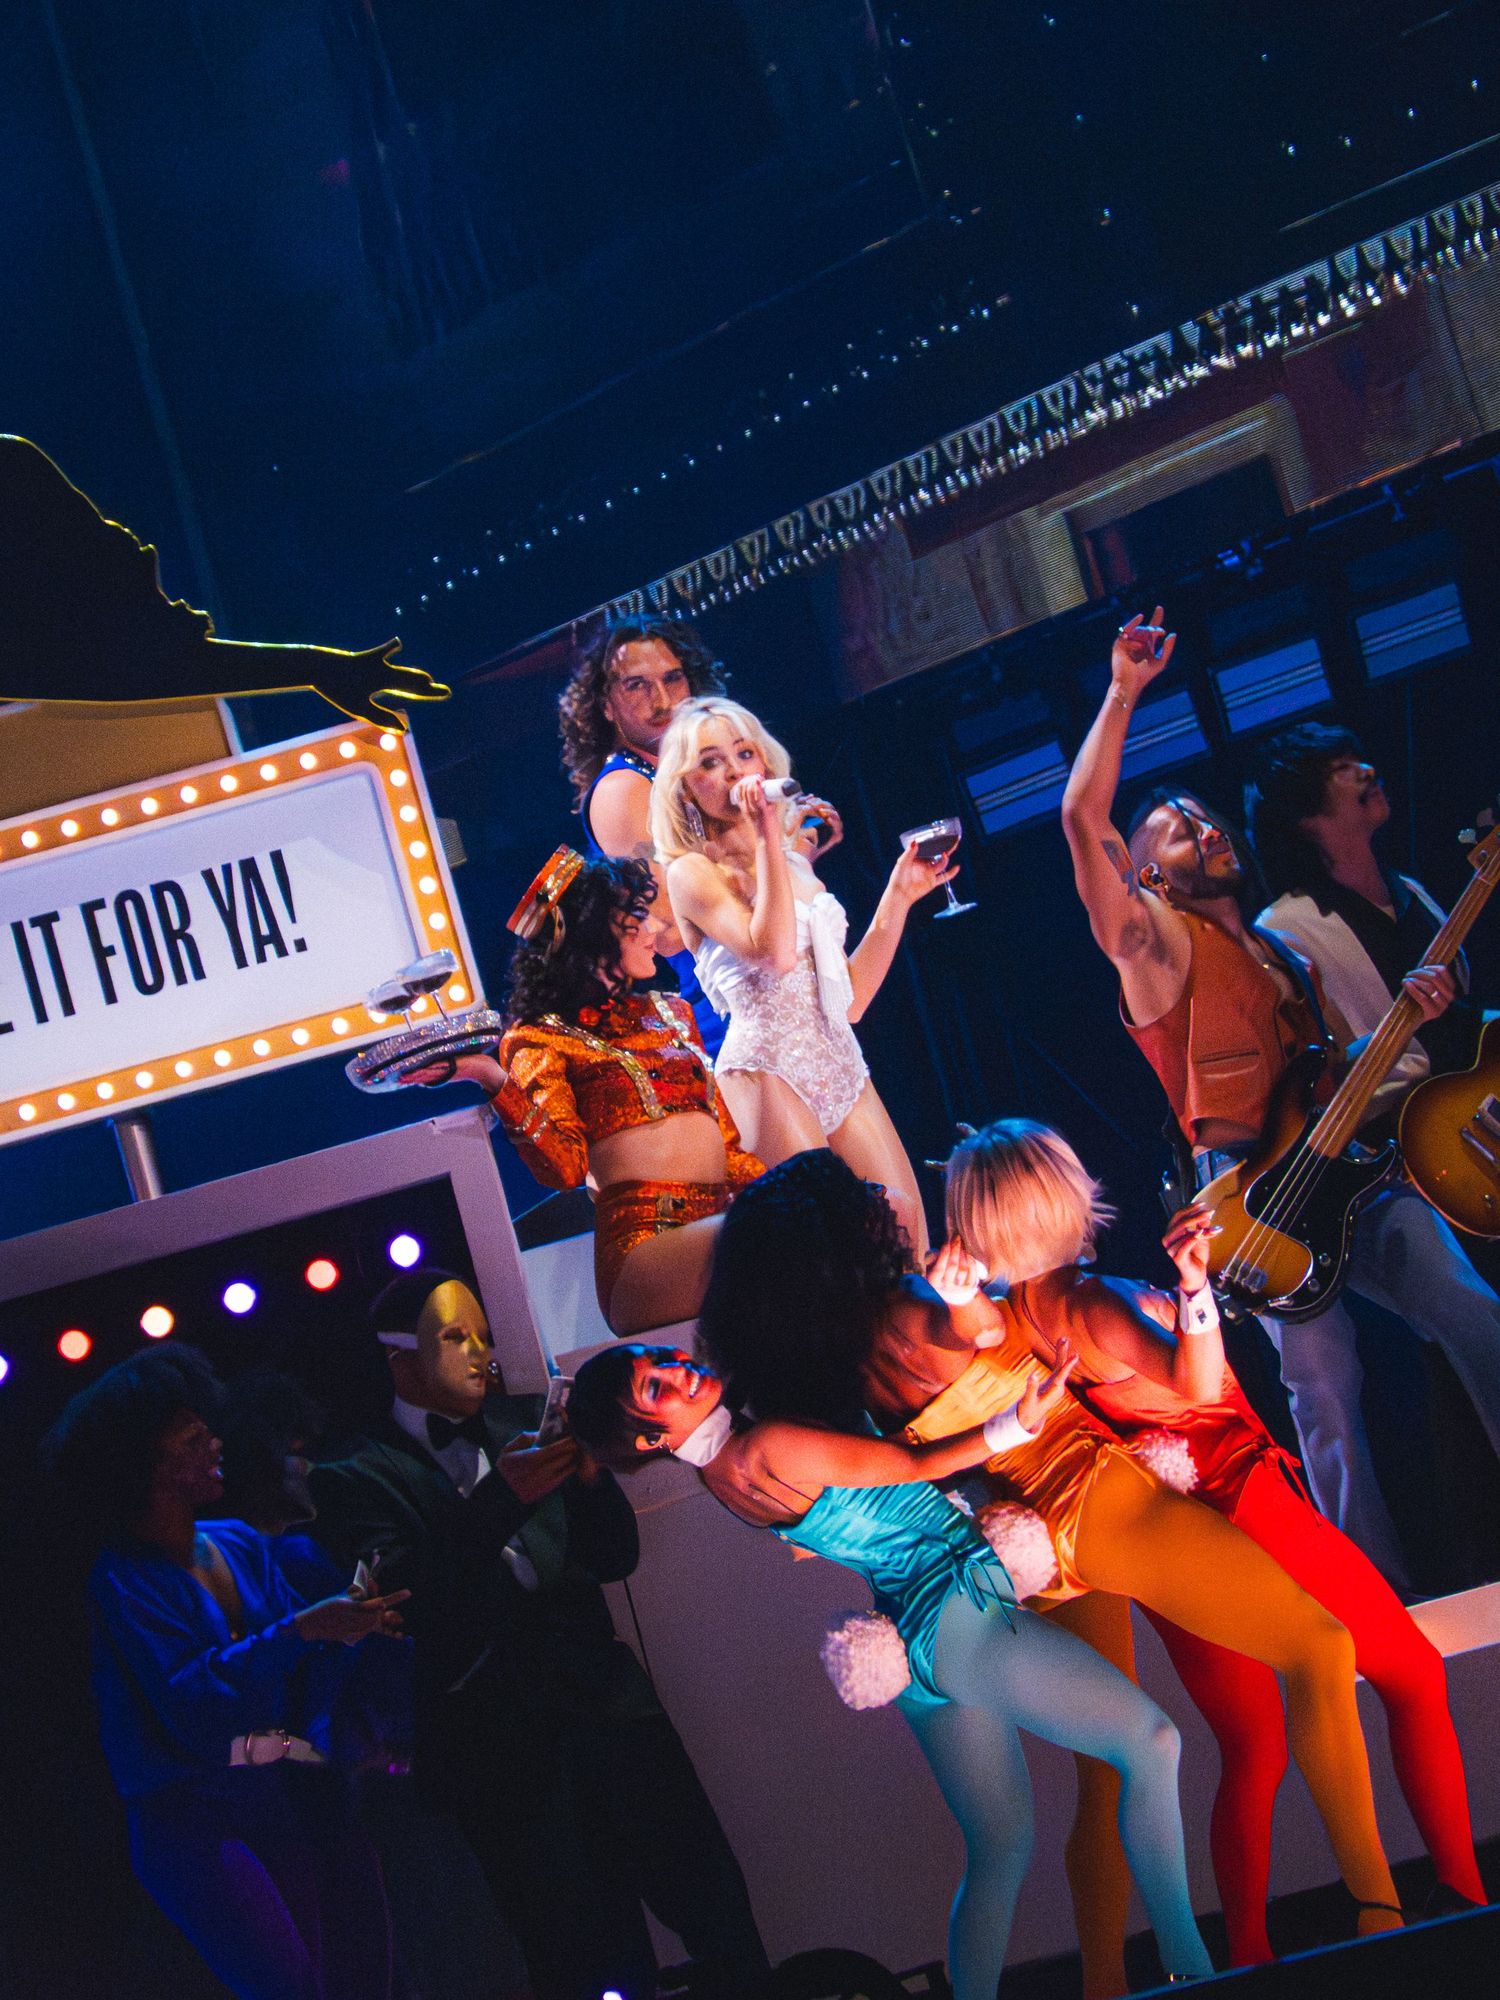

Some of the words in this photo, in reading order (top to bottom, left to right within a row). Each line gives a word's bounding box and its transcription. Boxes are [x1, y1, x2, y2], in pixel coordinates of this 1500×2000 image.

[10, 910, 76, 1024] IT
[79, 879, 207, 1005] FOR
[200, 849, 308, 970] YA!
